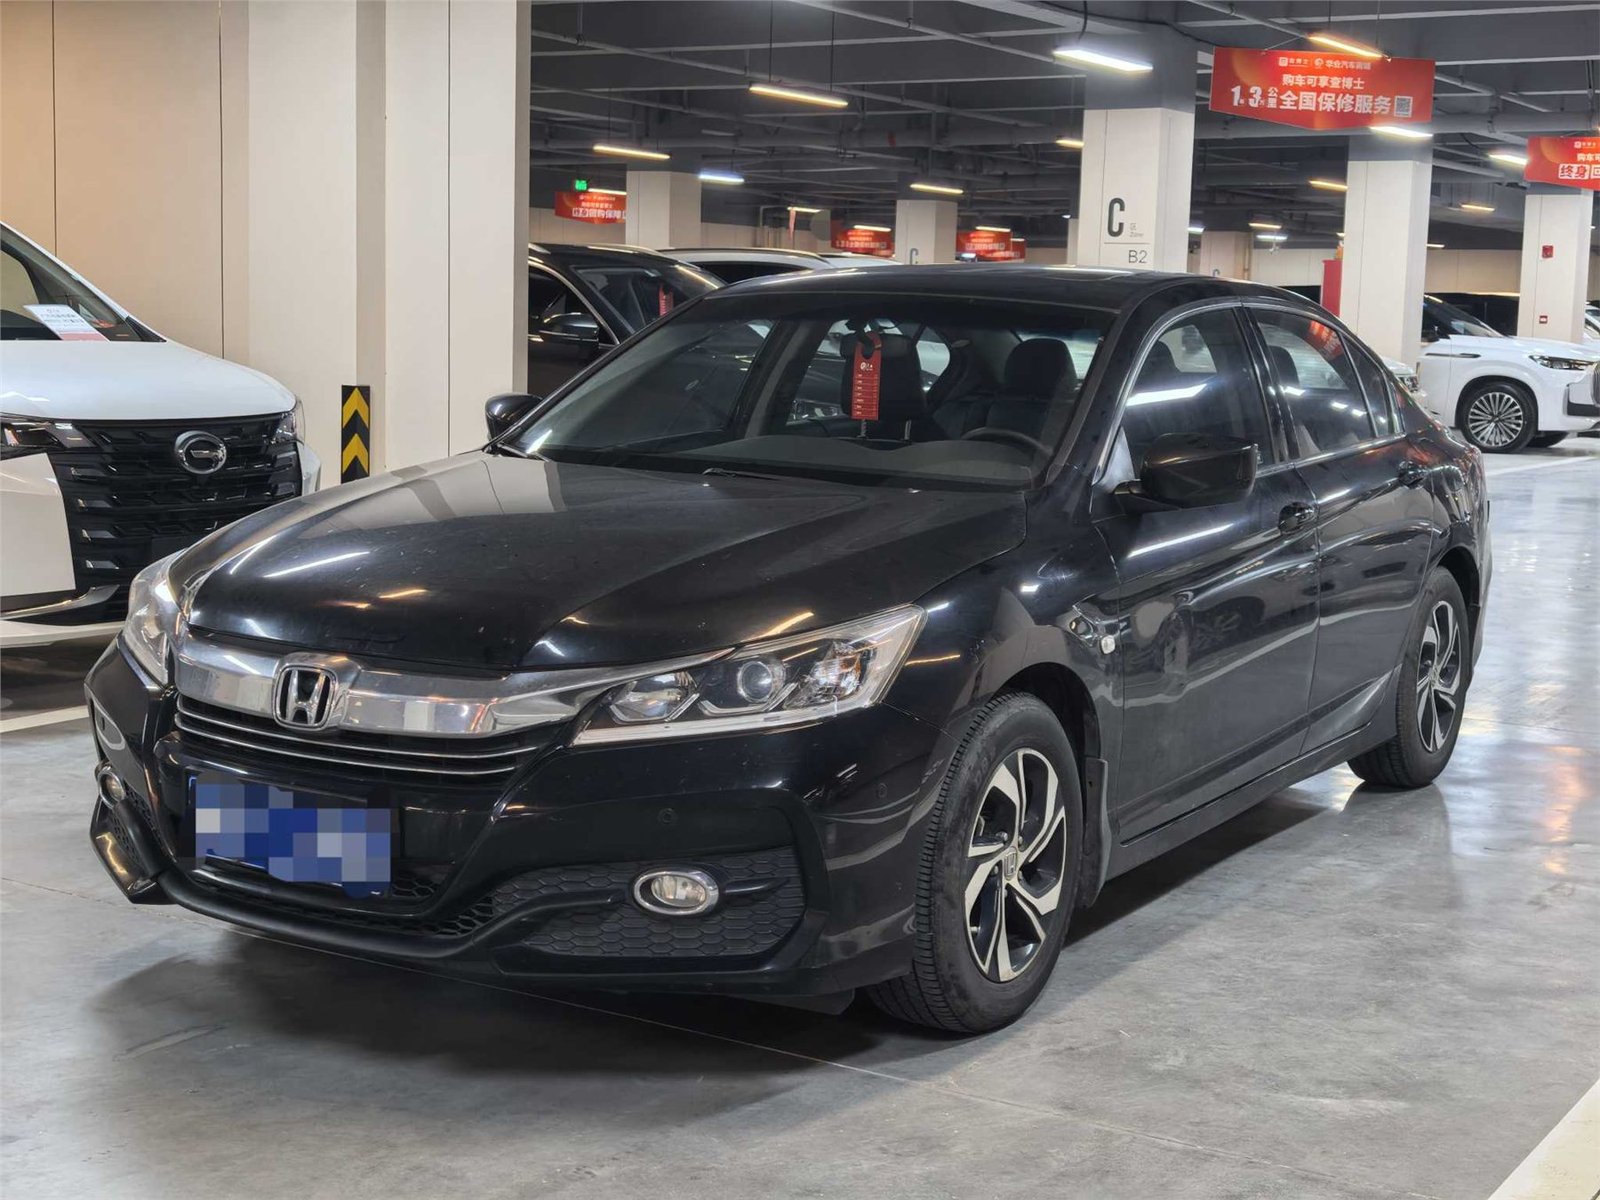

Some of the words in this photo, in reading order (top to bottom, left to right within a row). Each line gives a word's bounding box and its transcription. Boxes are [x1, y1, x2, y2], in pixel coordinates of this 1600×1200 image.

[1282, 74, 1365, 90] 购车可享查博士
[1107, 197, 1126, 238] C
[1128, 249, 1148, 264] B2
